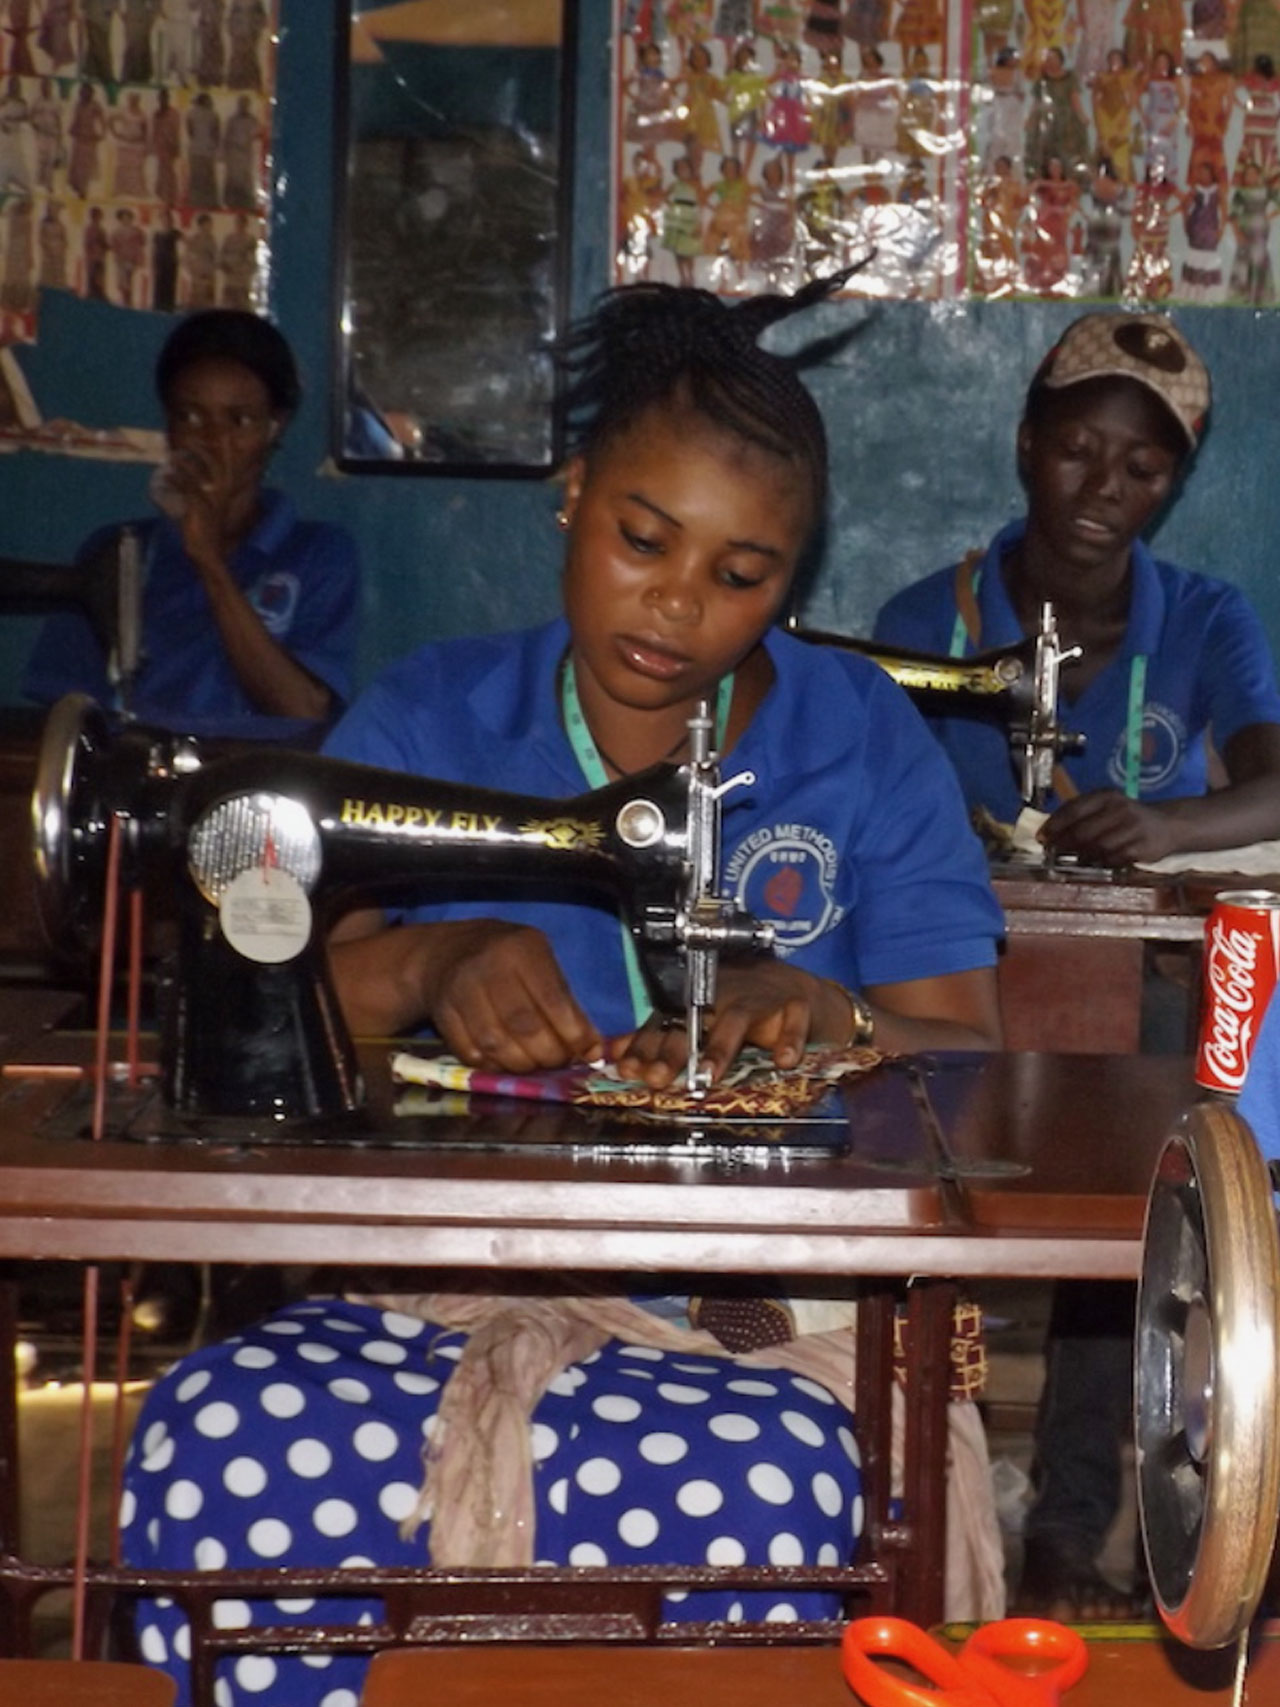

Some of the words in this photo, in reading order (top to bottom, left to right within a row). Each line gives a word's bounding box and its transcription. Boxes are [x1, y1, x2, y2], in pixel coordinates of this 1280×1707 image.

[340, 798, 443, 828] HAPPY
[724, 827, 773, 882] UNITED
[774, 823, 838, 891] METHODIST
[1204, 917, 1258, 1087] Coca-Cola
